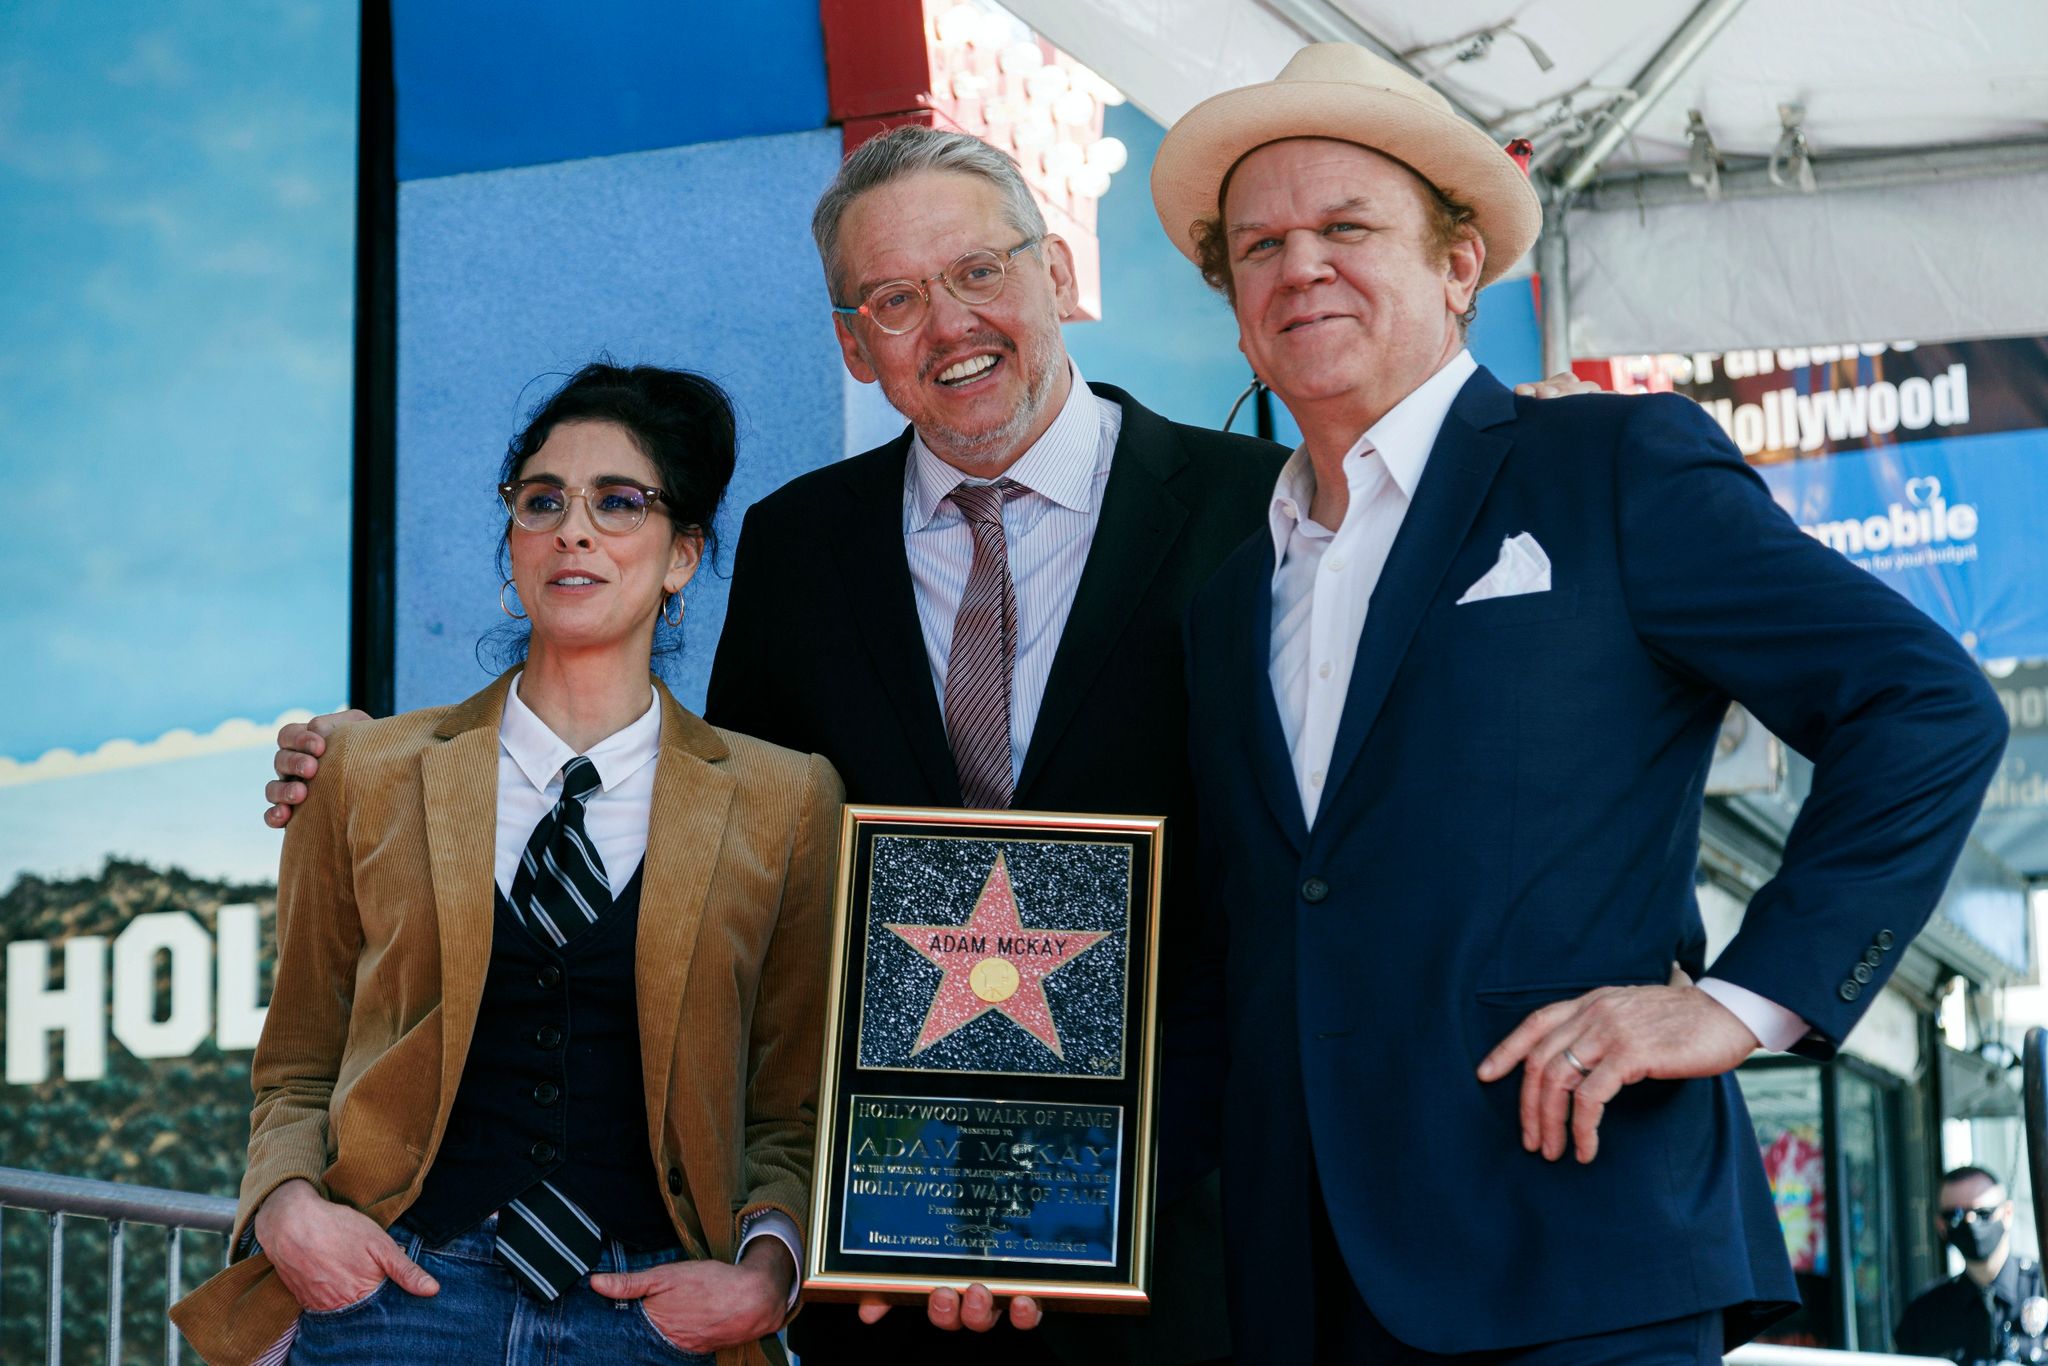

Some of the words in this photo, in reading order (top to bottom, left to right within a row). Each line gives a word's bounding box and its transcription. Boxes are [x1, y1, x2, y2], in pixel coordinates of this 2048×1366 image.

[929, 935, 986, 954] ADAM
[997, 937, 1067, 956] MCKAY
[858, 1103, 969, 1121] HOLLYWOOD
[975, 1106, 1028, 1125] WALK
[1034, 1109, 1057, 1126] OF
[1062, 1111, 1113, 1128] FAME
[857, 1137, 964, 1160] ADAM
[853, 1164, 866, 1173] ON
[868, 1164, 885, 1174] THE
[929, 1166, 942, 1176] OF
[943, 1167, 961, 1177] THE
[852, 1179, 964, 1199] HOLLYWOOD
[970, 1183, 1023, 1202] WALK
[1030, 1187, 1052, 1203] OF
[1059, 1188, 1109, 1205] FAME
